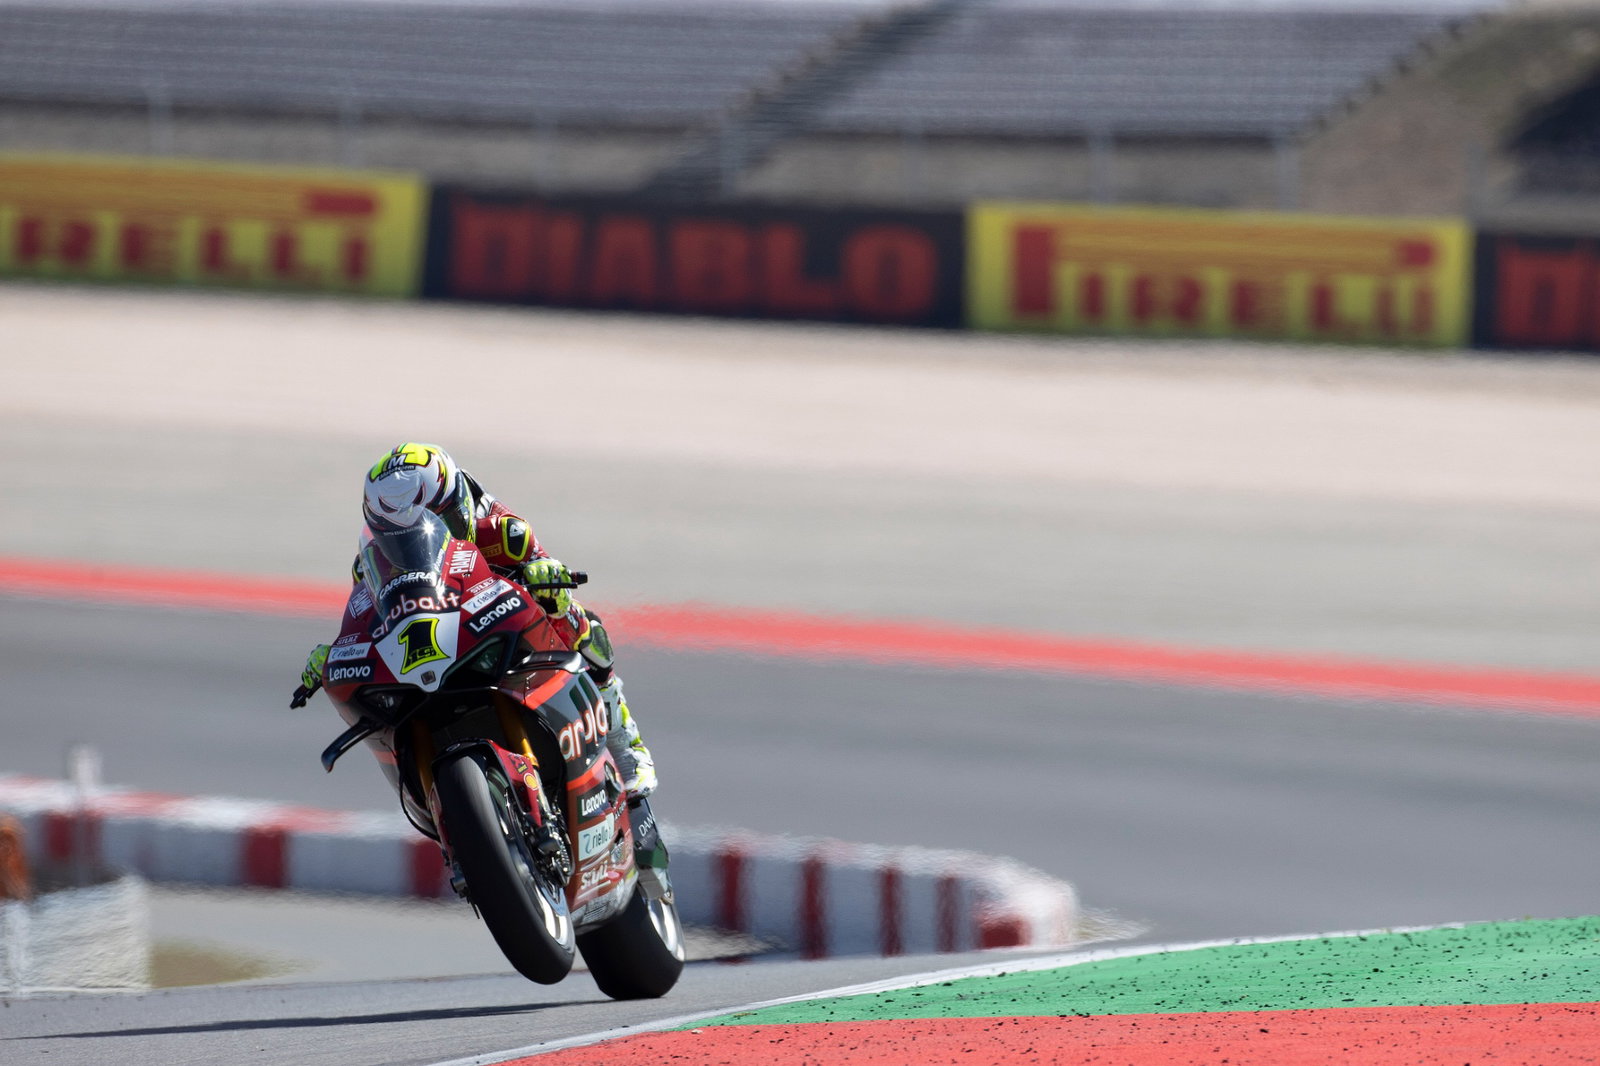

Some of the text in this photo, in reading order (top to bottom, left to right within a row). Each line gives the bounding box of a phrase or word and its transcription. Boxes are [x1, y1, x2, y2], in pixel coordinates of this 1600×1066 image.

[0, 166, 378, 283] RELLI
[449, 203, 940, 318] DIABLO
[1012, 220, 1438, 338] PIRELLI
[380, 571, 437, 599] CARRERA
[371, 592, 460, 639] aruba.it
[469, 597, 521, 632] Lenovo
[398, 618, 450, 675] 1
[329, 665, 371, 682] Lenovo
[581, 789, 606, 817] Lenovo
